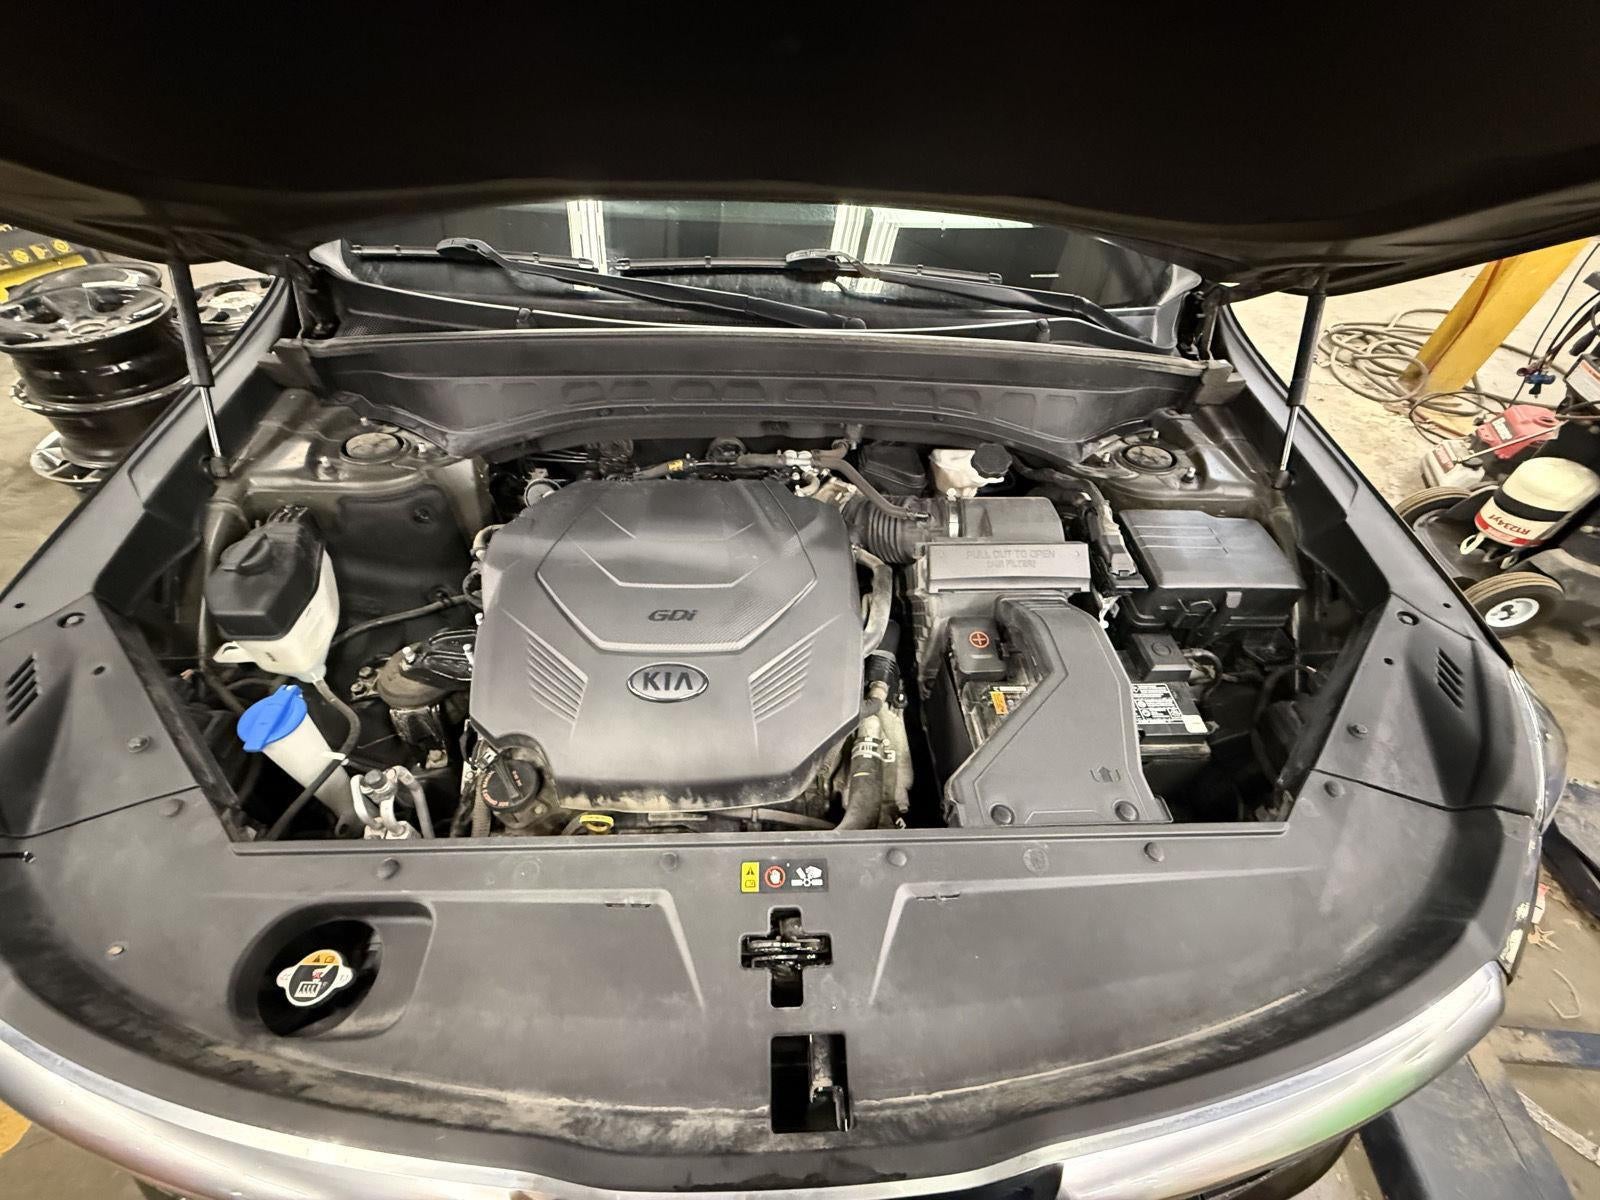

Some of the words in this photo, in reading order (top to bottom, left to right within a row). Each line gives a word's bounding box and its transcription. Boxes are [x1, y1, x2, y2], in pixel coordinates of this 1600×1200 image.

[1488, 514, 1531, 535] R1234yf
[966, 549, 992, 560] PULL
[993, 549, 1011, 559] OUT
[1013, 549, 1028, 559] TO
[1029, 549, 1056, 559] OPEN
[648, 609, 698, 622] GDi
[642, 671, 694, 691] KIA
